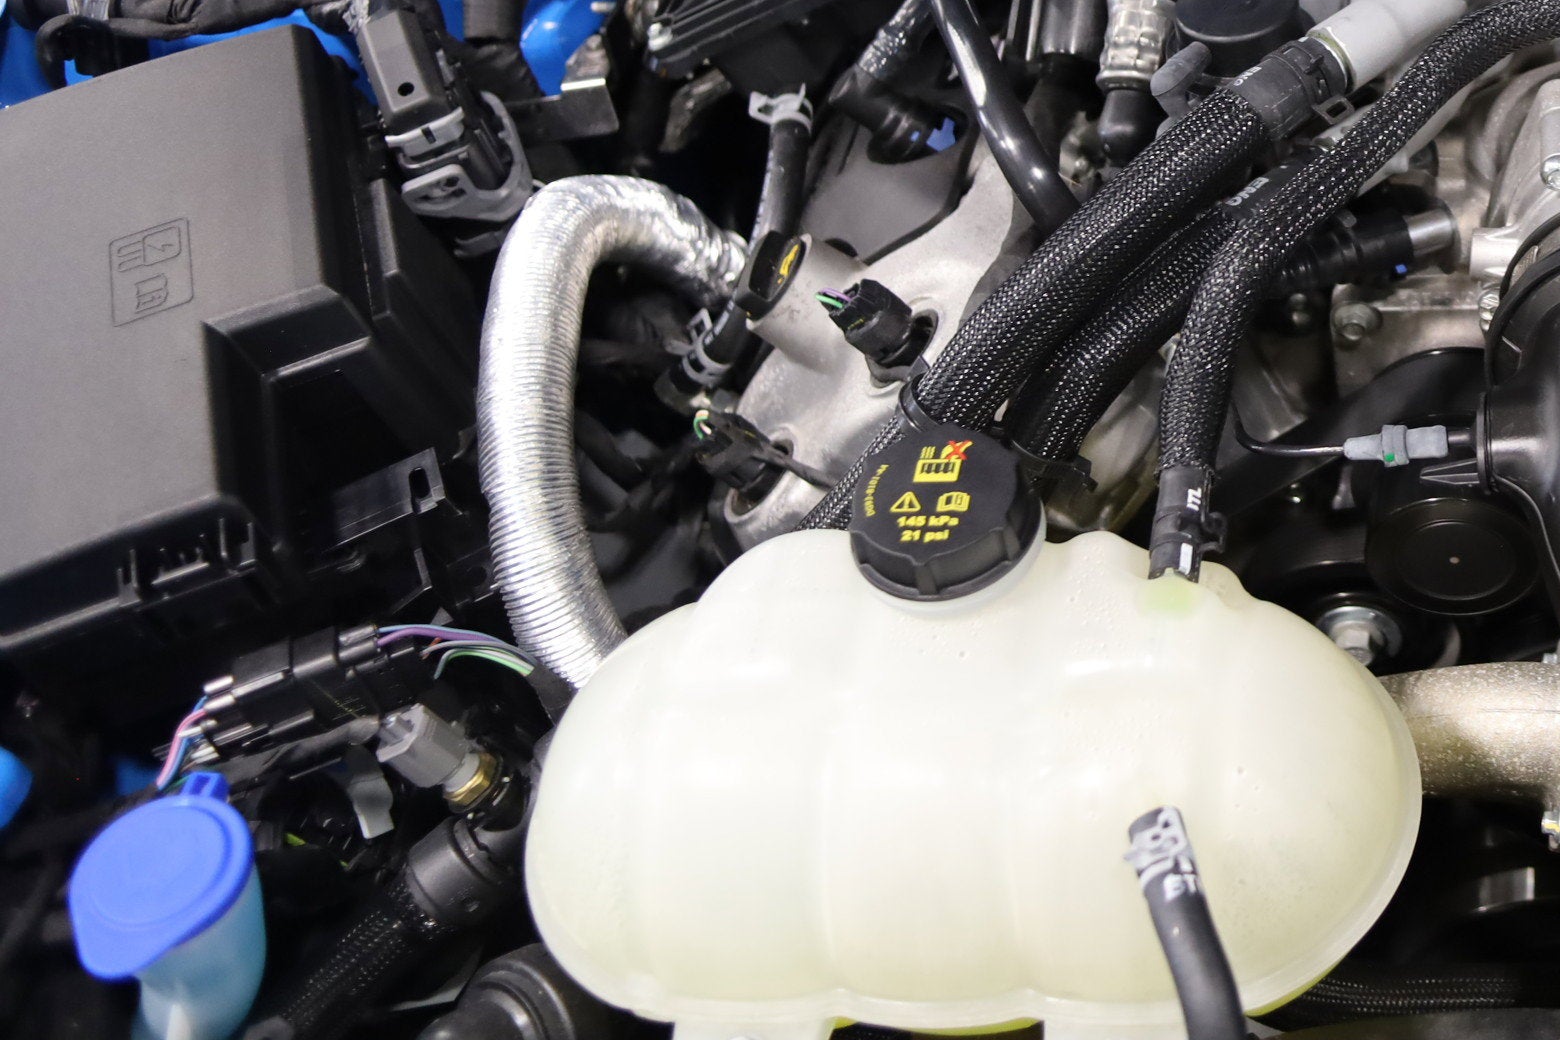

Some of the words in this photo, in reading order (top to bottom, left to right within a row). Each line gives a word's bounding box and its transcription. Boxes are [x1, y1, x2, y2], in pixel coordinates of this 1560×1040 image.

[896, 515, 927, 527] 145
[928, 515, 960, 527] kPa
[900, 529, 921, 541] 21
[923, 529, 950, 543] psi
